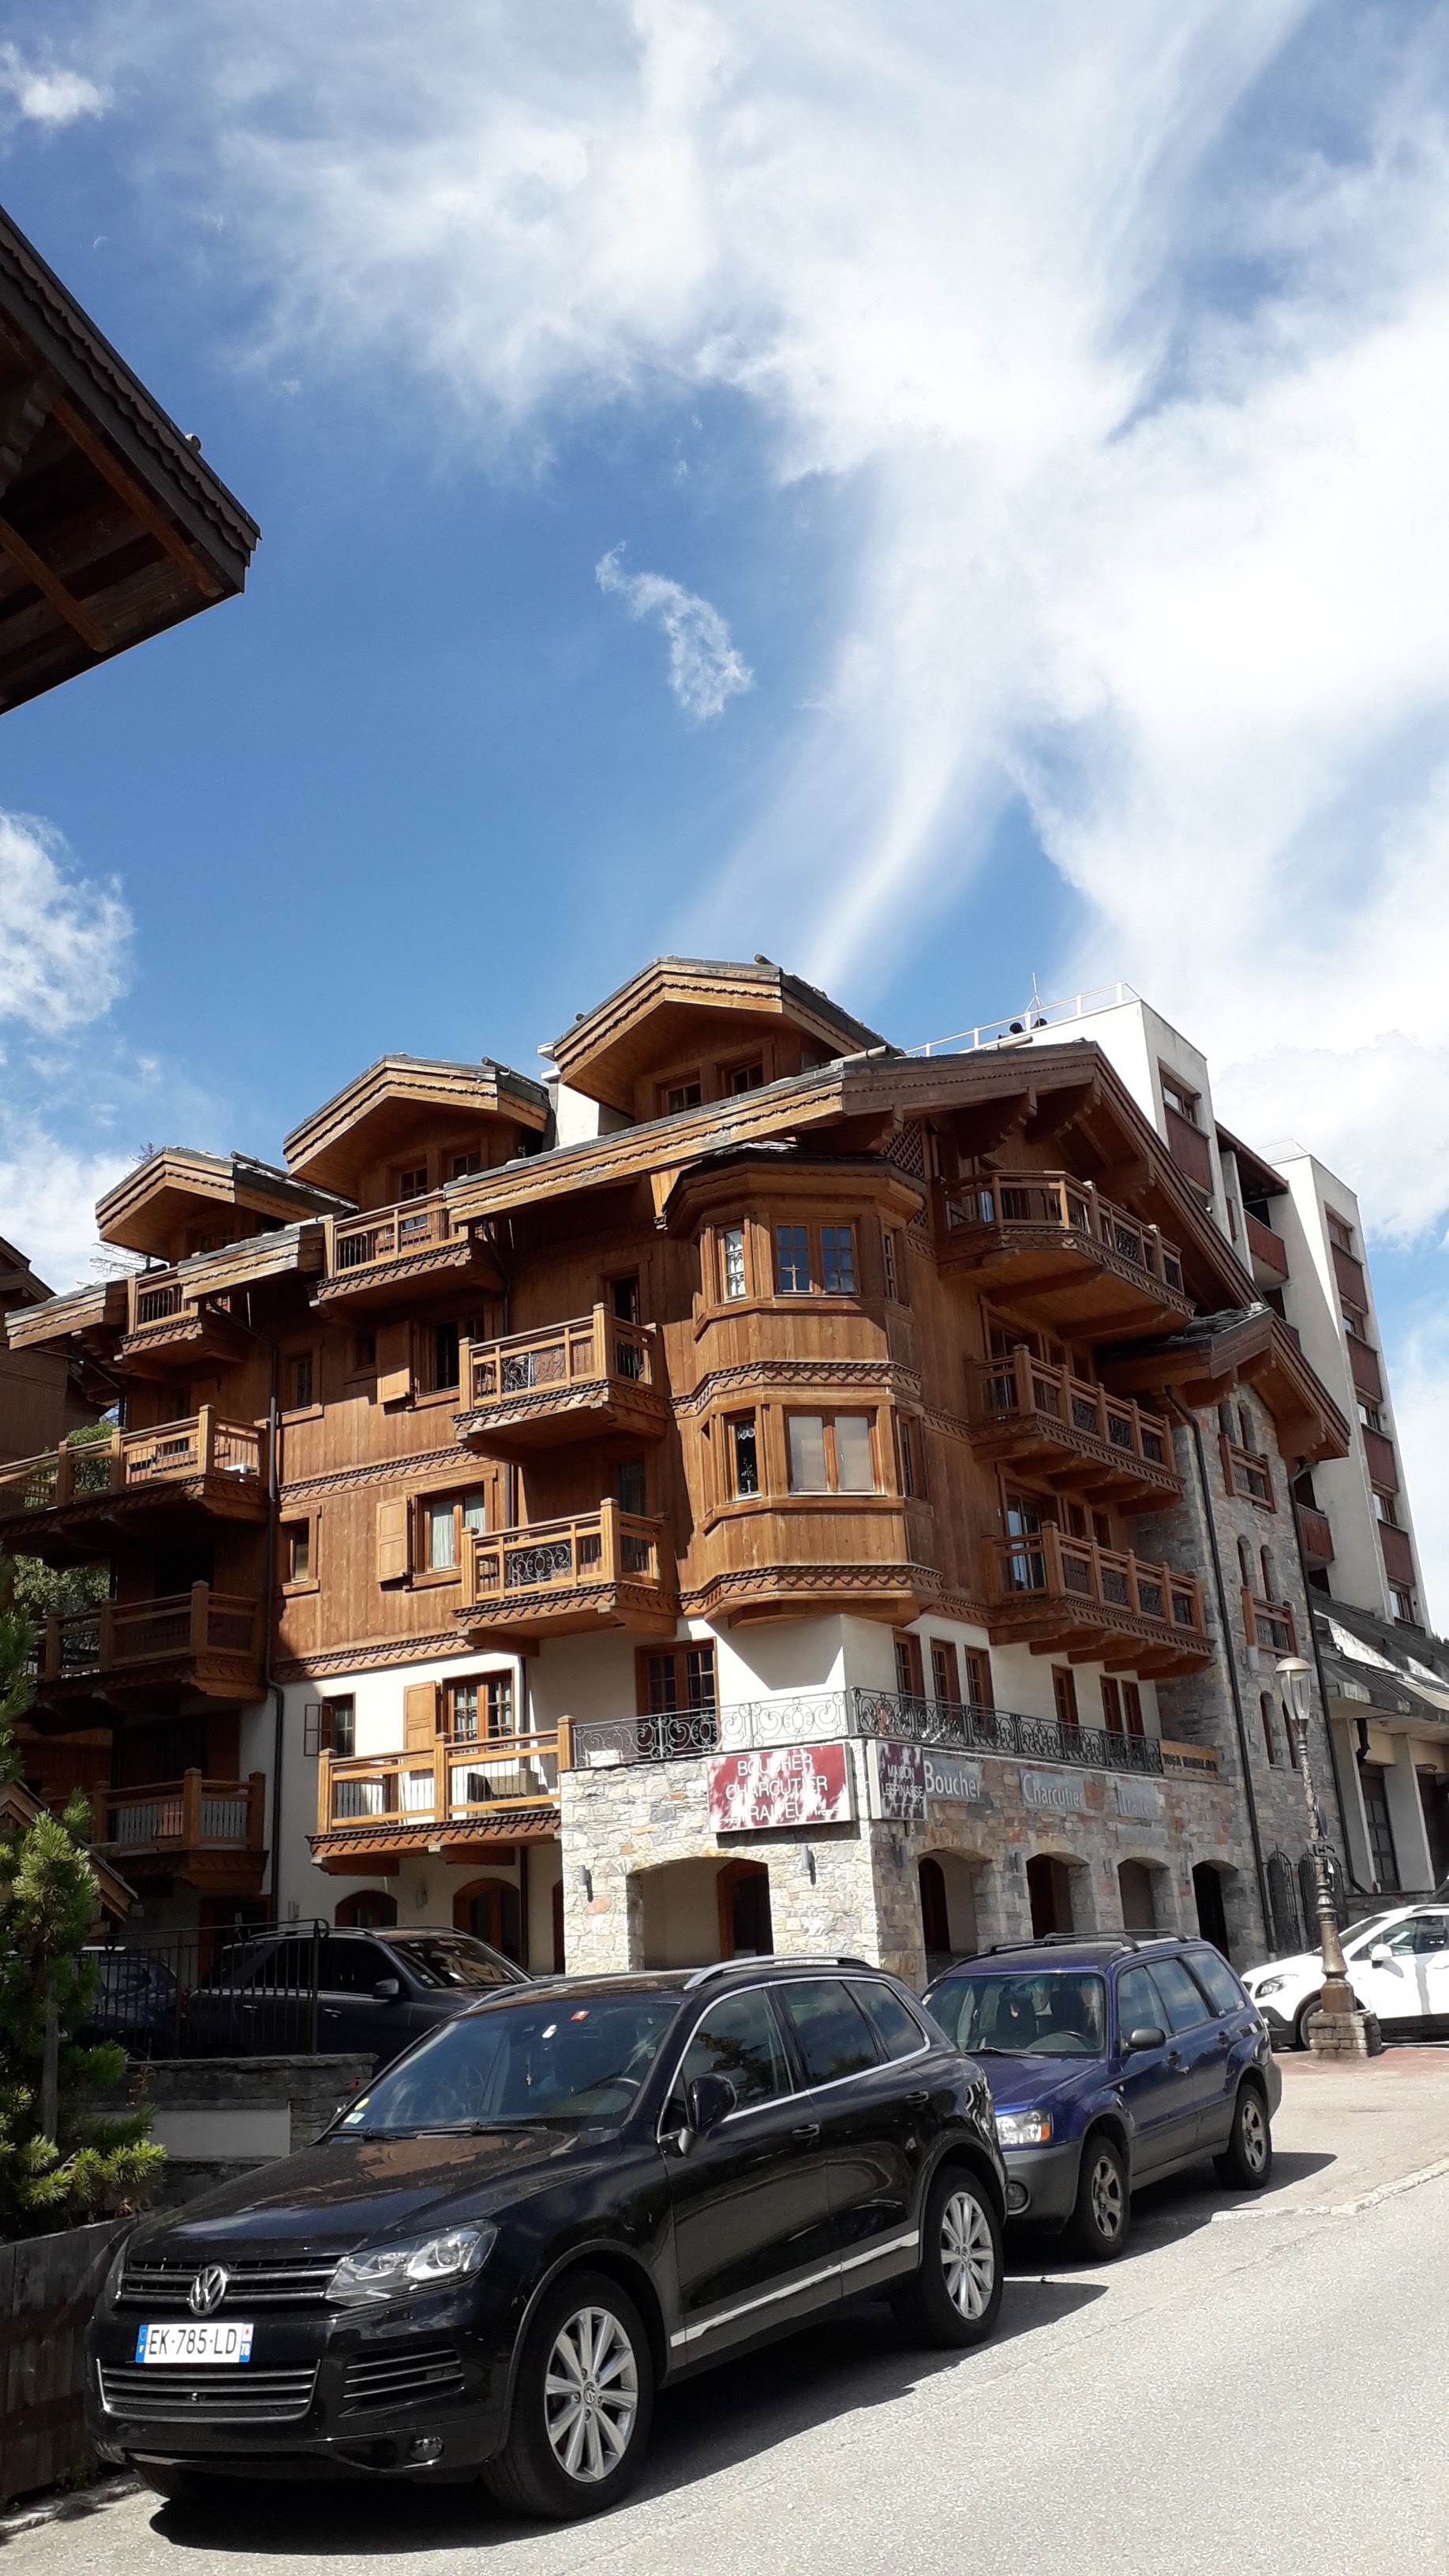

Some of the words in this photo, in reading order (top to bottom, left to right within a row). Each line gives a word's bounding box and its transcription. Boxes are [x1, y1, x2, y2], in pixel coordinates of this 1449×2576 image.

[887, 1764, 915, 1780] MAISON
[923, 1760, 982, 1798] Boucher
[725, 1776, 828, 1801] CHARCUTIER
[881, 1782, 924, 1799] LESPINASSE
[1022, 1773, 1084, 1808] Charcutier
[736, 1797, 818, 1822] RAITEU
[148, 2328, 238, 2355] EK-785-LD
